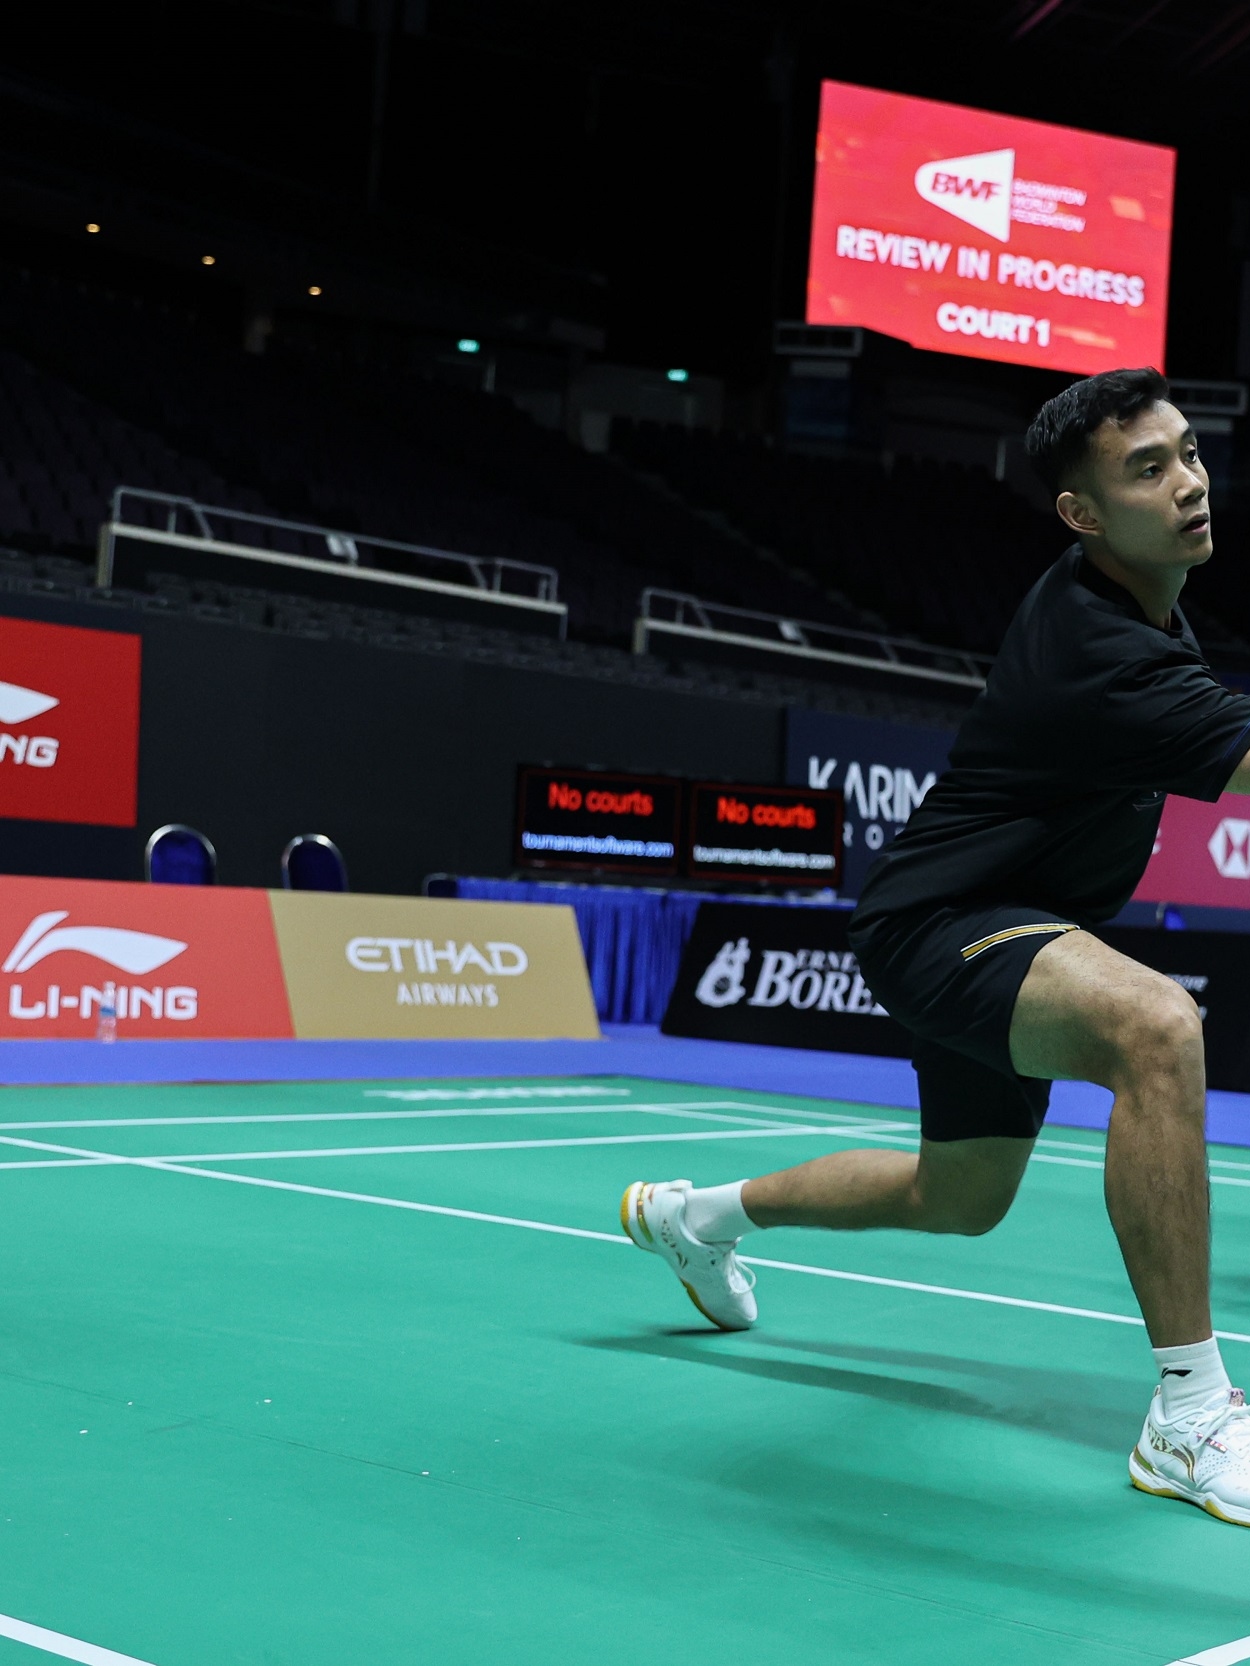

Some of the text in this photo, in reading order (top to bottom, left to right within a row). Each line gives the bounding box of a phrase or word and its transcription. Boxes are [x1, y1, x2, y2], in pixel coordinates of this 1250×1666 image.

[932, 172, 1002, 202] BWF
[836, 224, 1145, 307] REVIEW IN PROGRESS
[936, 301, 1050, 347] COURT 1
[549, 782, 654, 816] No courts
[717, 796, 816, 829] No courts
[346, 936, 529, 976] ETIHAD
[397, 982, 499, 1007] AIRWAYS
[747, 950, 890, 1017] BORE
[9, 984, 198, 1020] LI-NING
